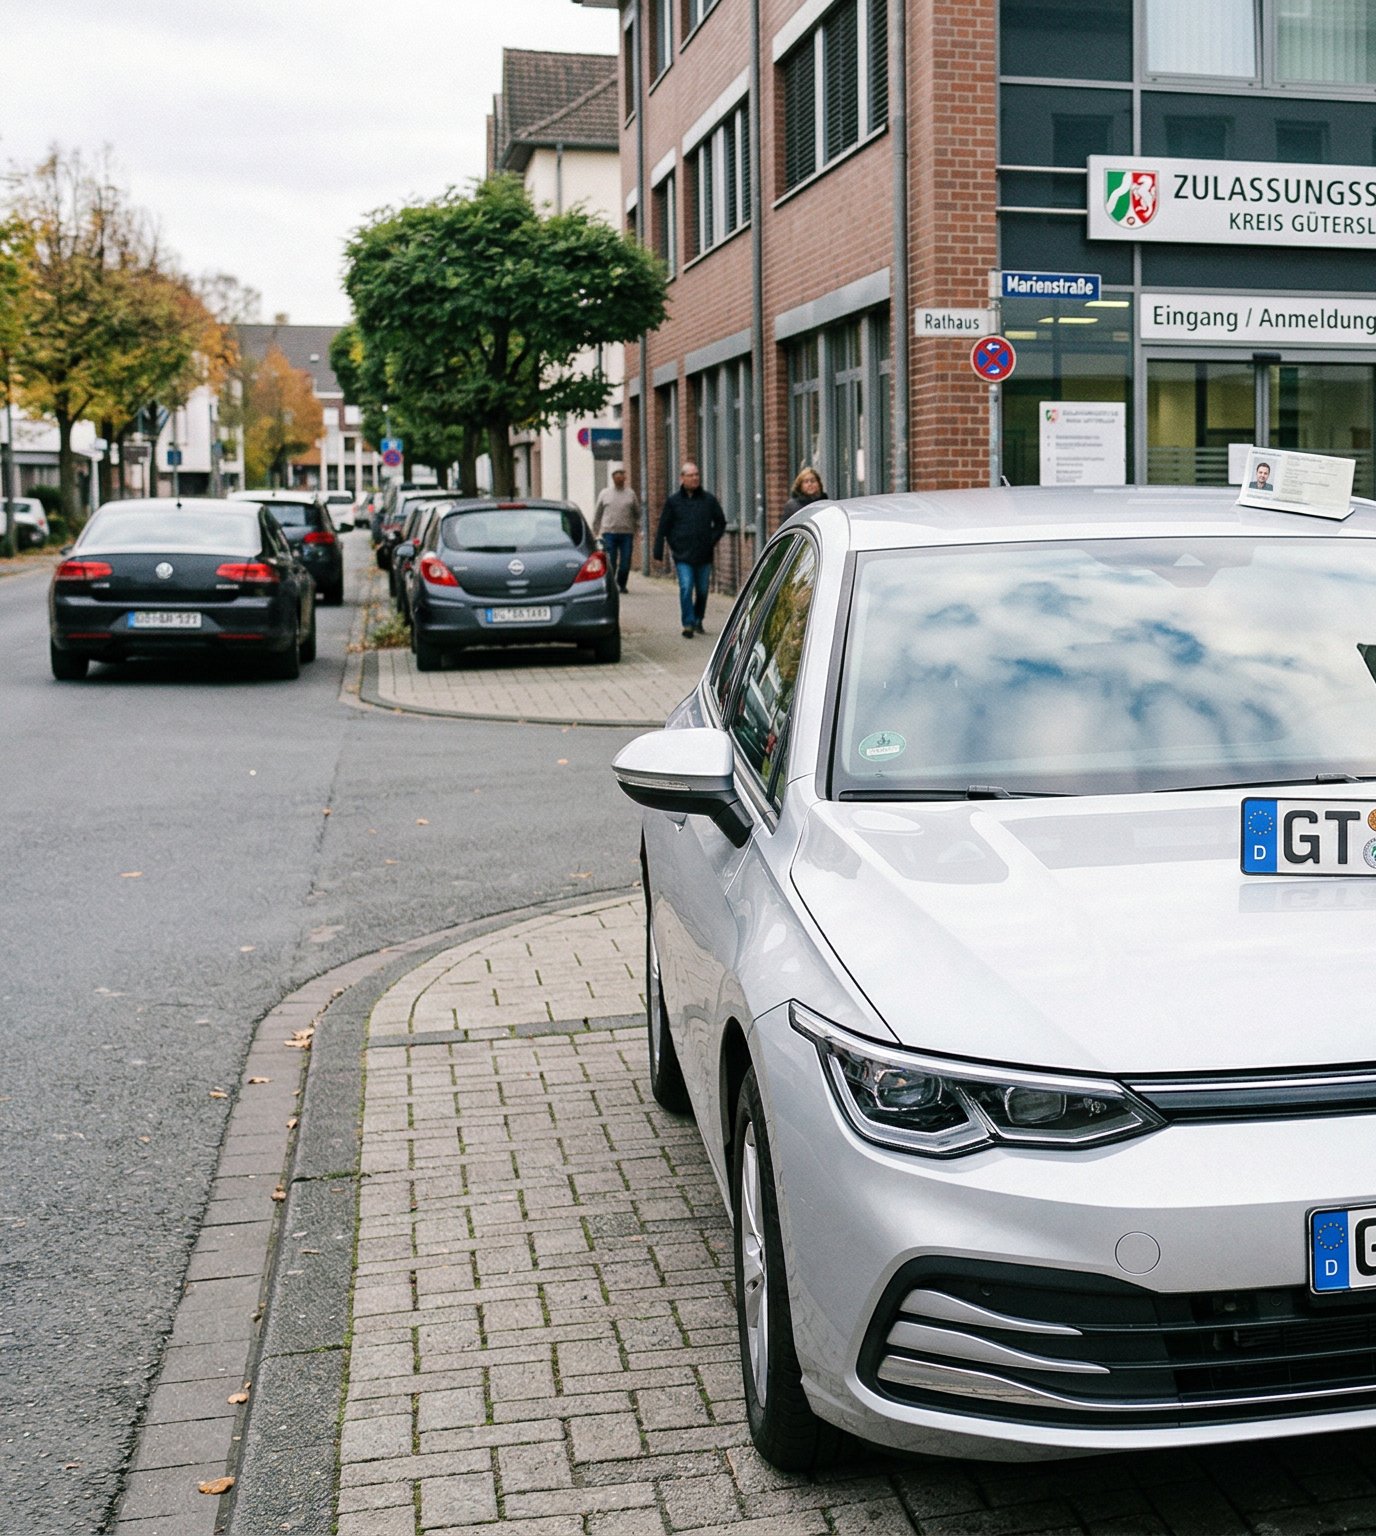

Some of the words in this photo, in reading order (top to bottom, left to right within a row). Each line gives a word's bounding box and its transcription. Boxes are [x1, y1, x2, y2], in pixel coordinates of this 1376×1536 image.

[1229, 212, 1284, 231] KREIS
[1007, 275, 1094, 295] Marienstraße
[925, 313, 980, 330] Rathaus
[1153, 305, 1238, 332] Eingang
[1245, 307, 1252, 328] /
[1259, 308, 1376, 334] Anmeldung
[1254, 845, 1266, 860] D
[1283, 809, 1361, 865] GT
[1325, 1259, 1338, 1276] D
